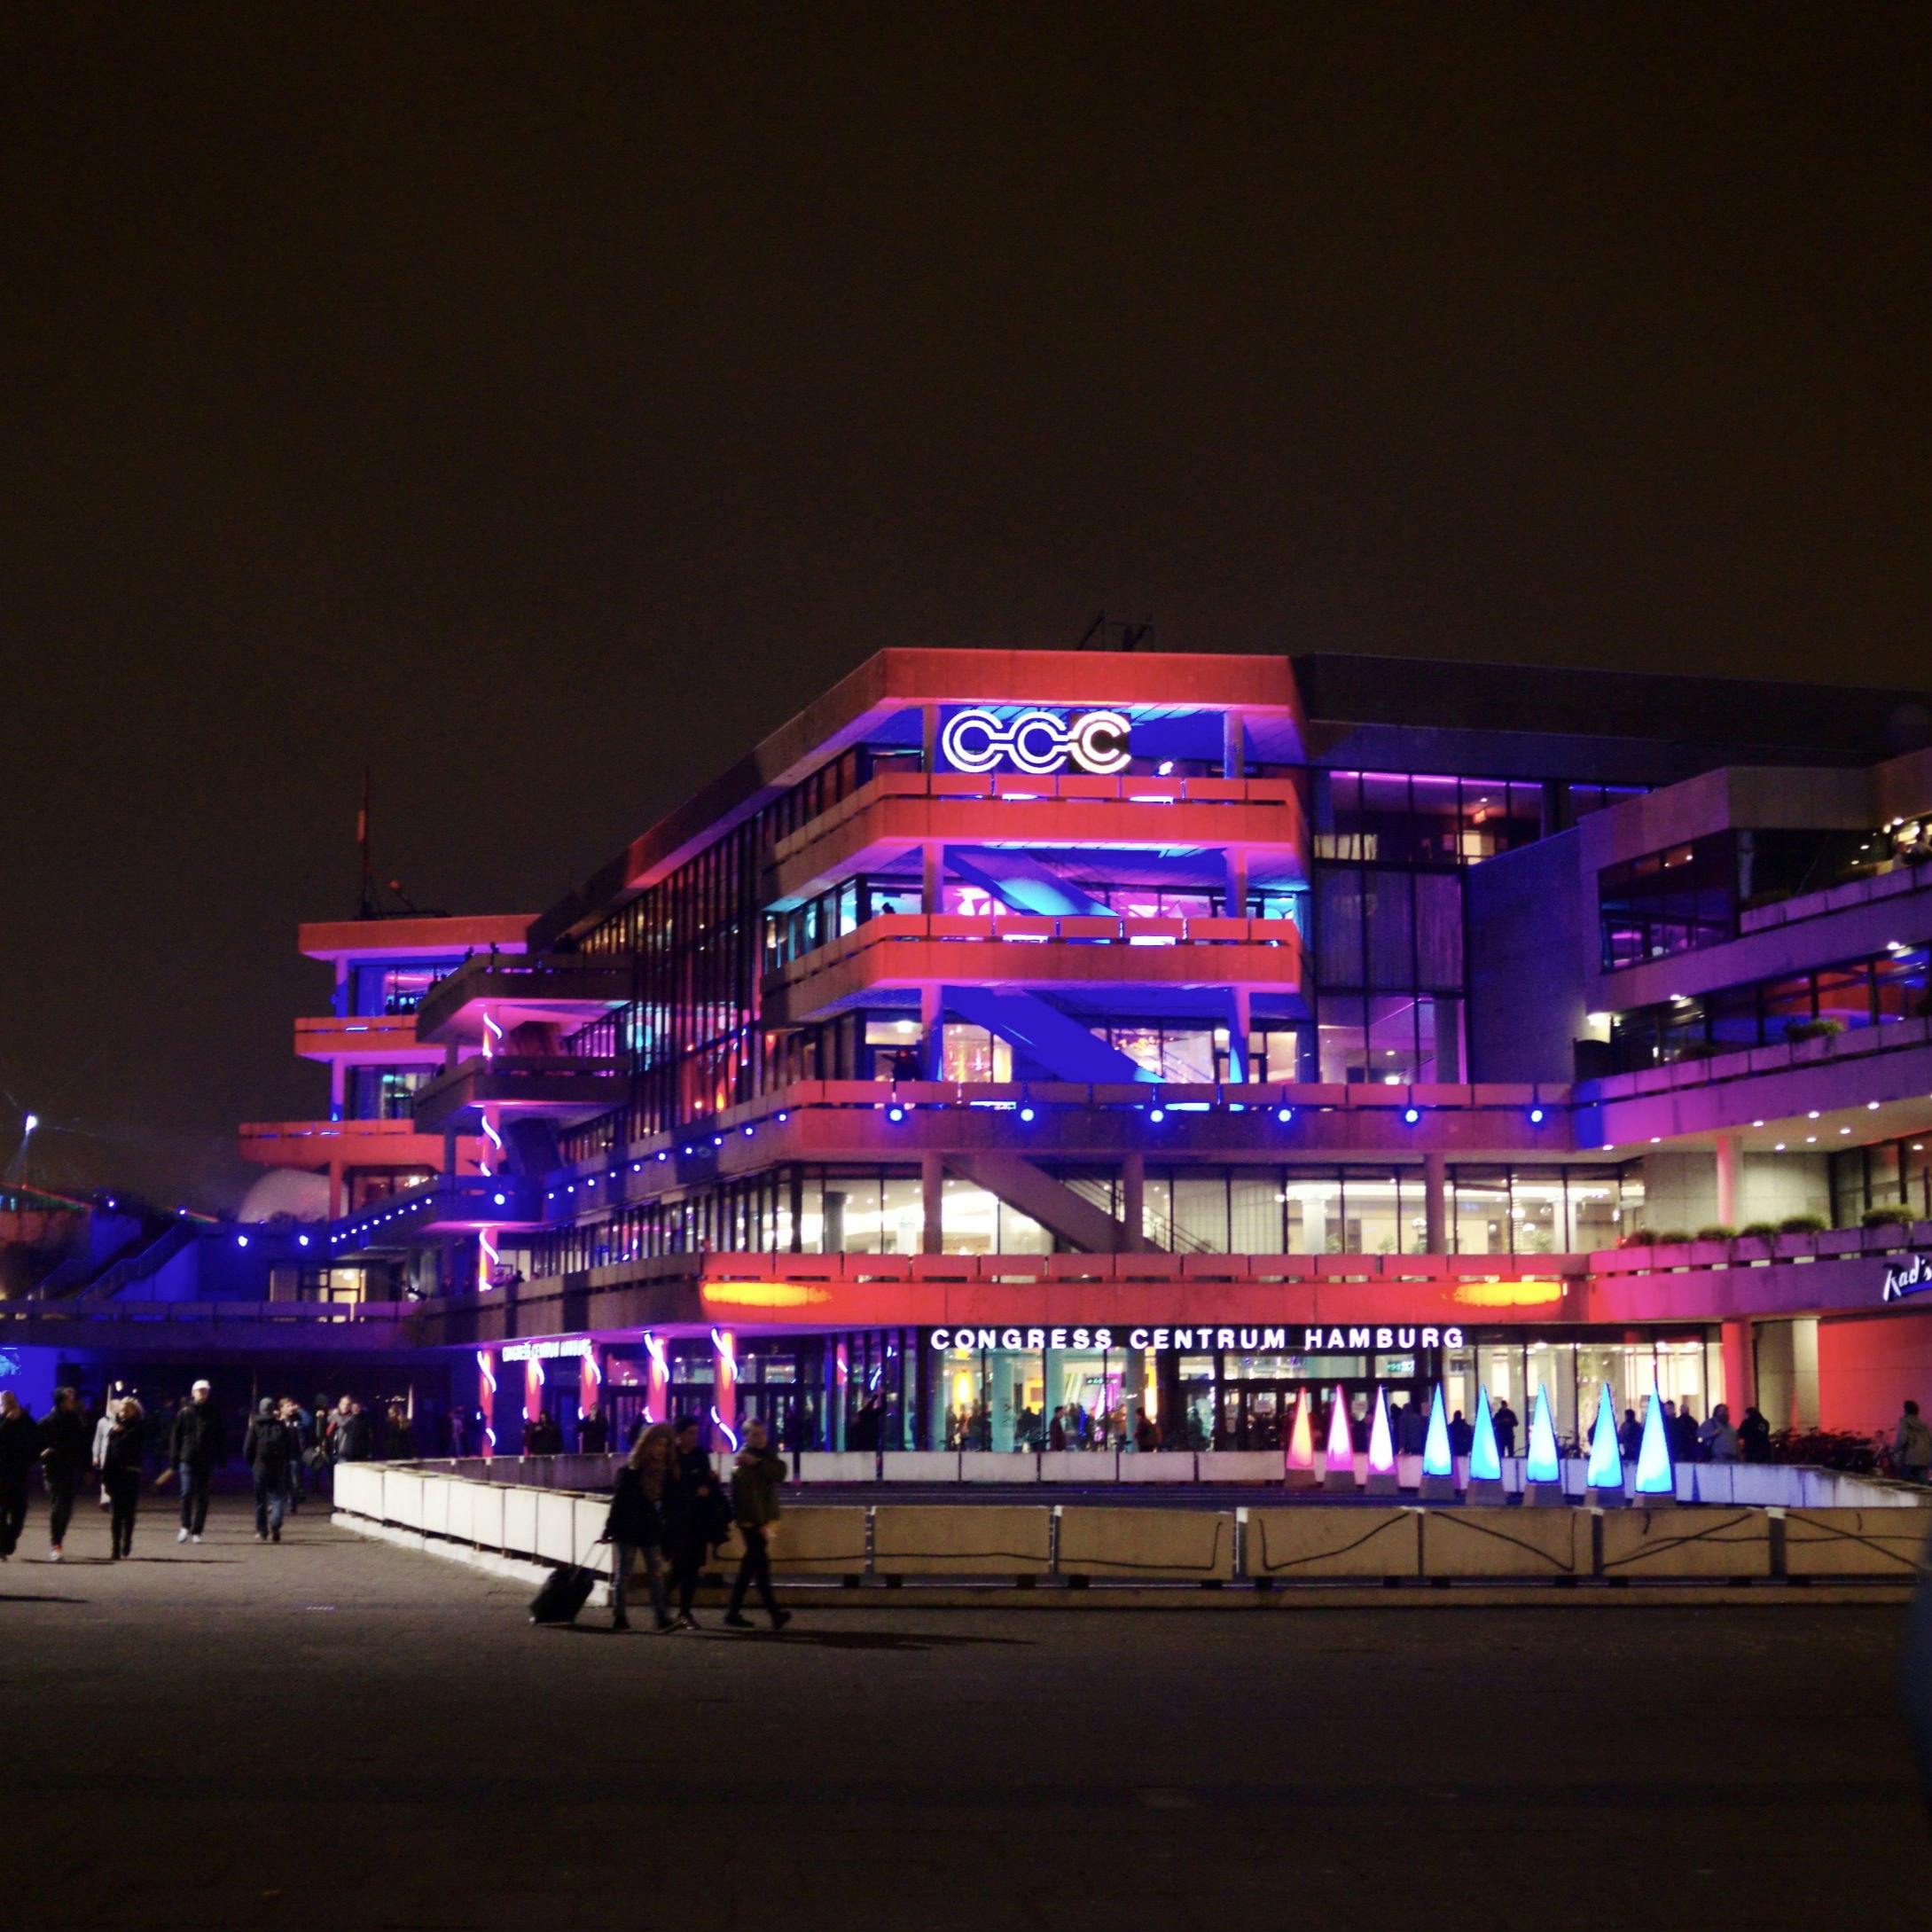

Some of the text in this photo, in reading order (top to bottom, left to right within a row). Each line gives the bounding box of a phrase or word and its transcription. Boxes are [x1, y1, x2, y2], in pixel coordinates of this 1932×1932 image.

[942, 709, 1132, 774] CCC
[930, 1327, 1464, 1350] CONGRESS CENTRUM HAMBURG
